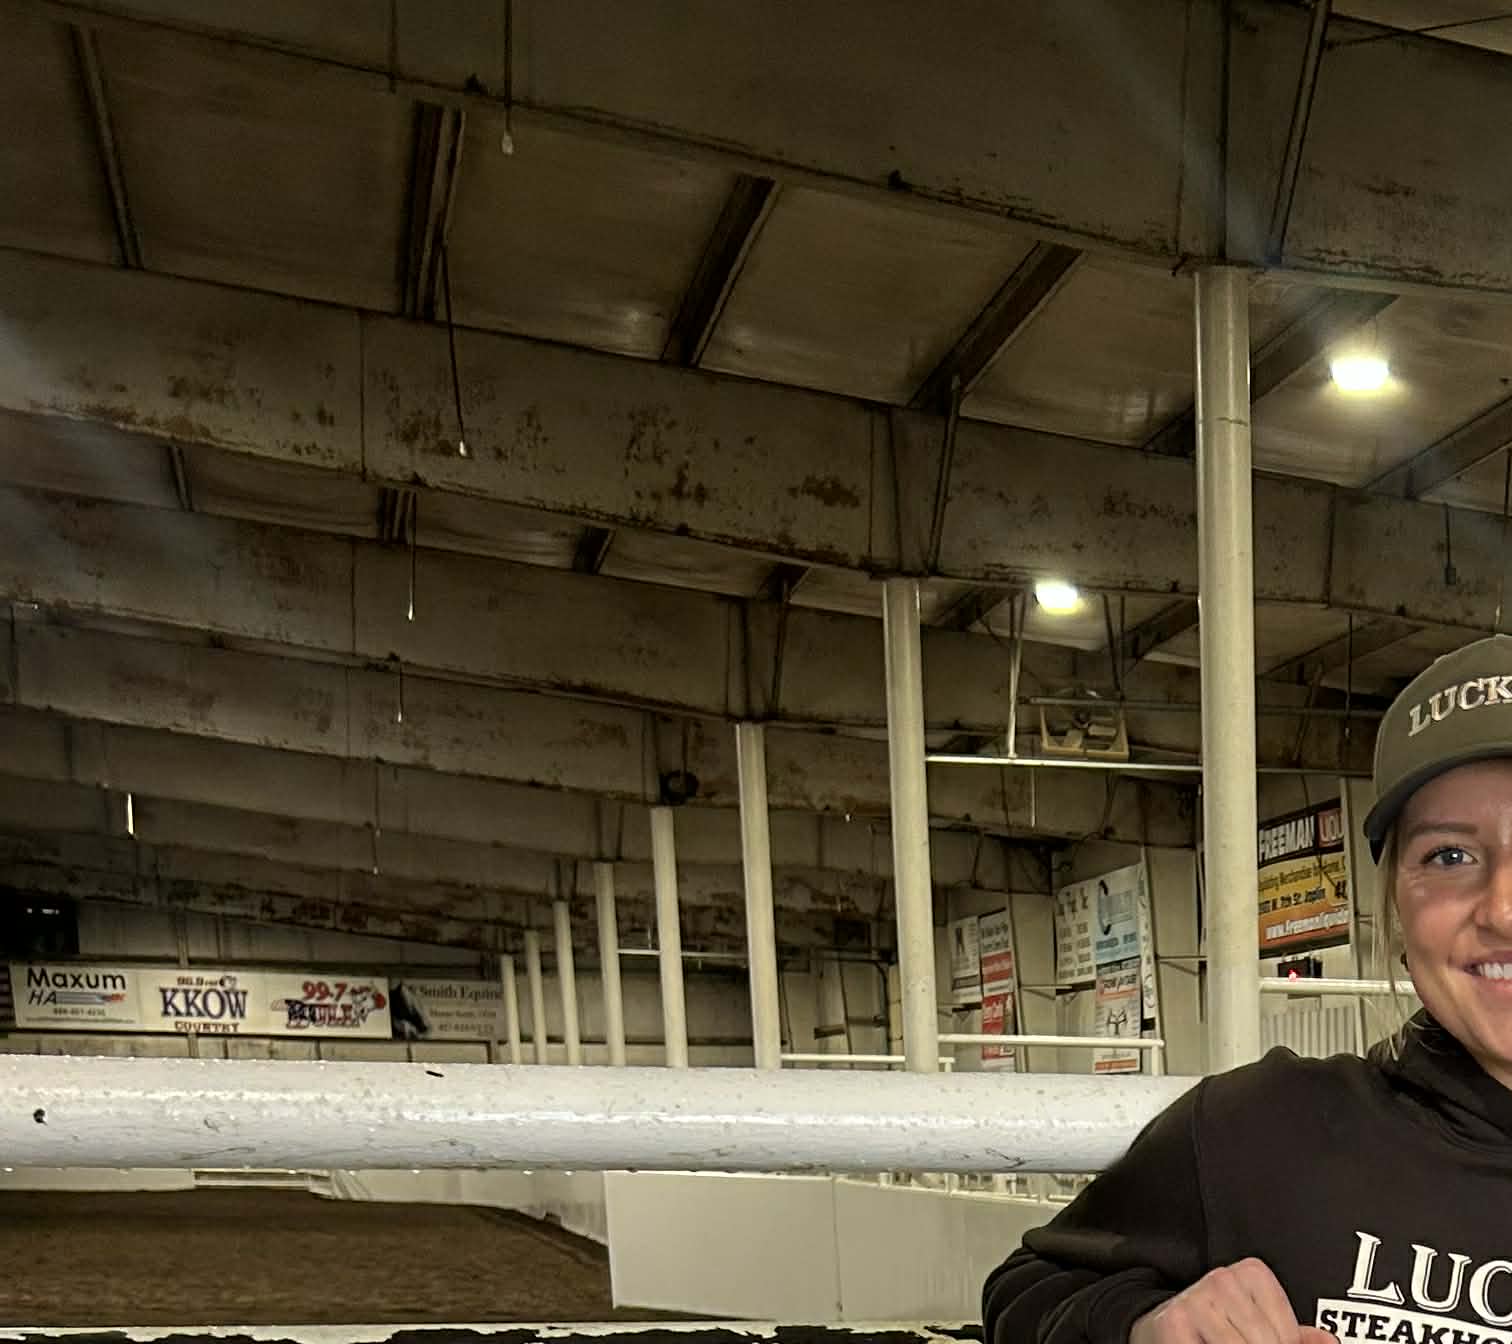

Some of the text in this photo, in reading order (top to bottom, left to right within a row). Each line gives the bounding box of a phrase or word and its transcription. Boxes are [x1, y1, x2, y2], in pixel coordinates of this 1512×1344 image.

[1259, 814, 1316, 864] FREEMAN
[27, 967, 126, 990] Maxum
[160, 987, 248, 1019] KKOW
